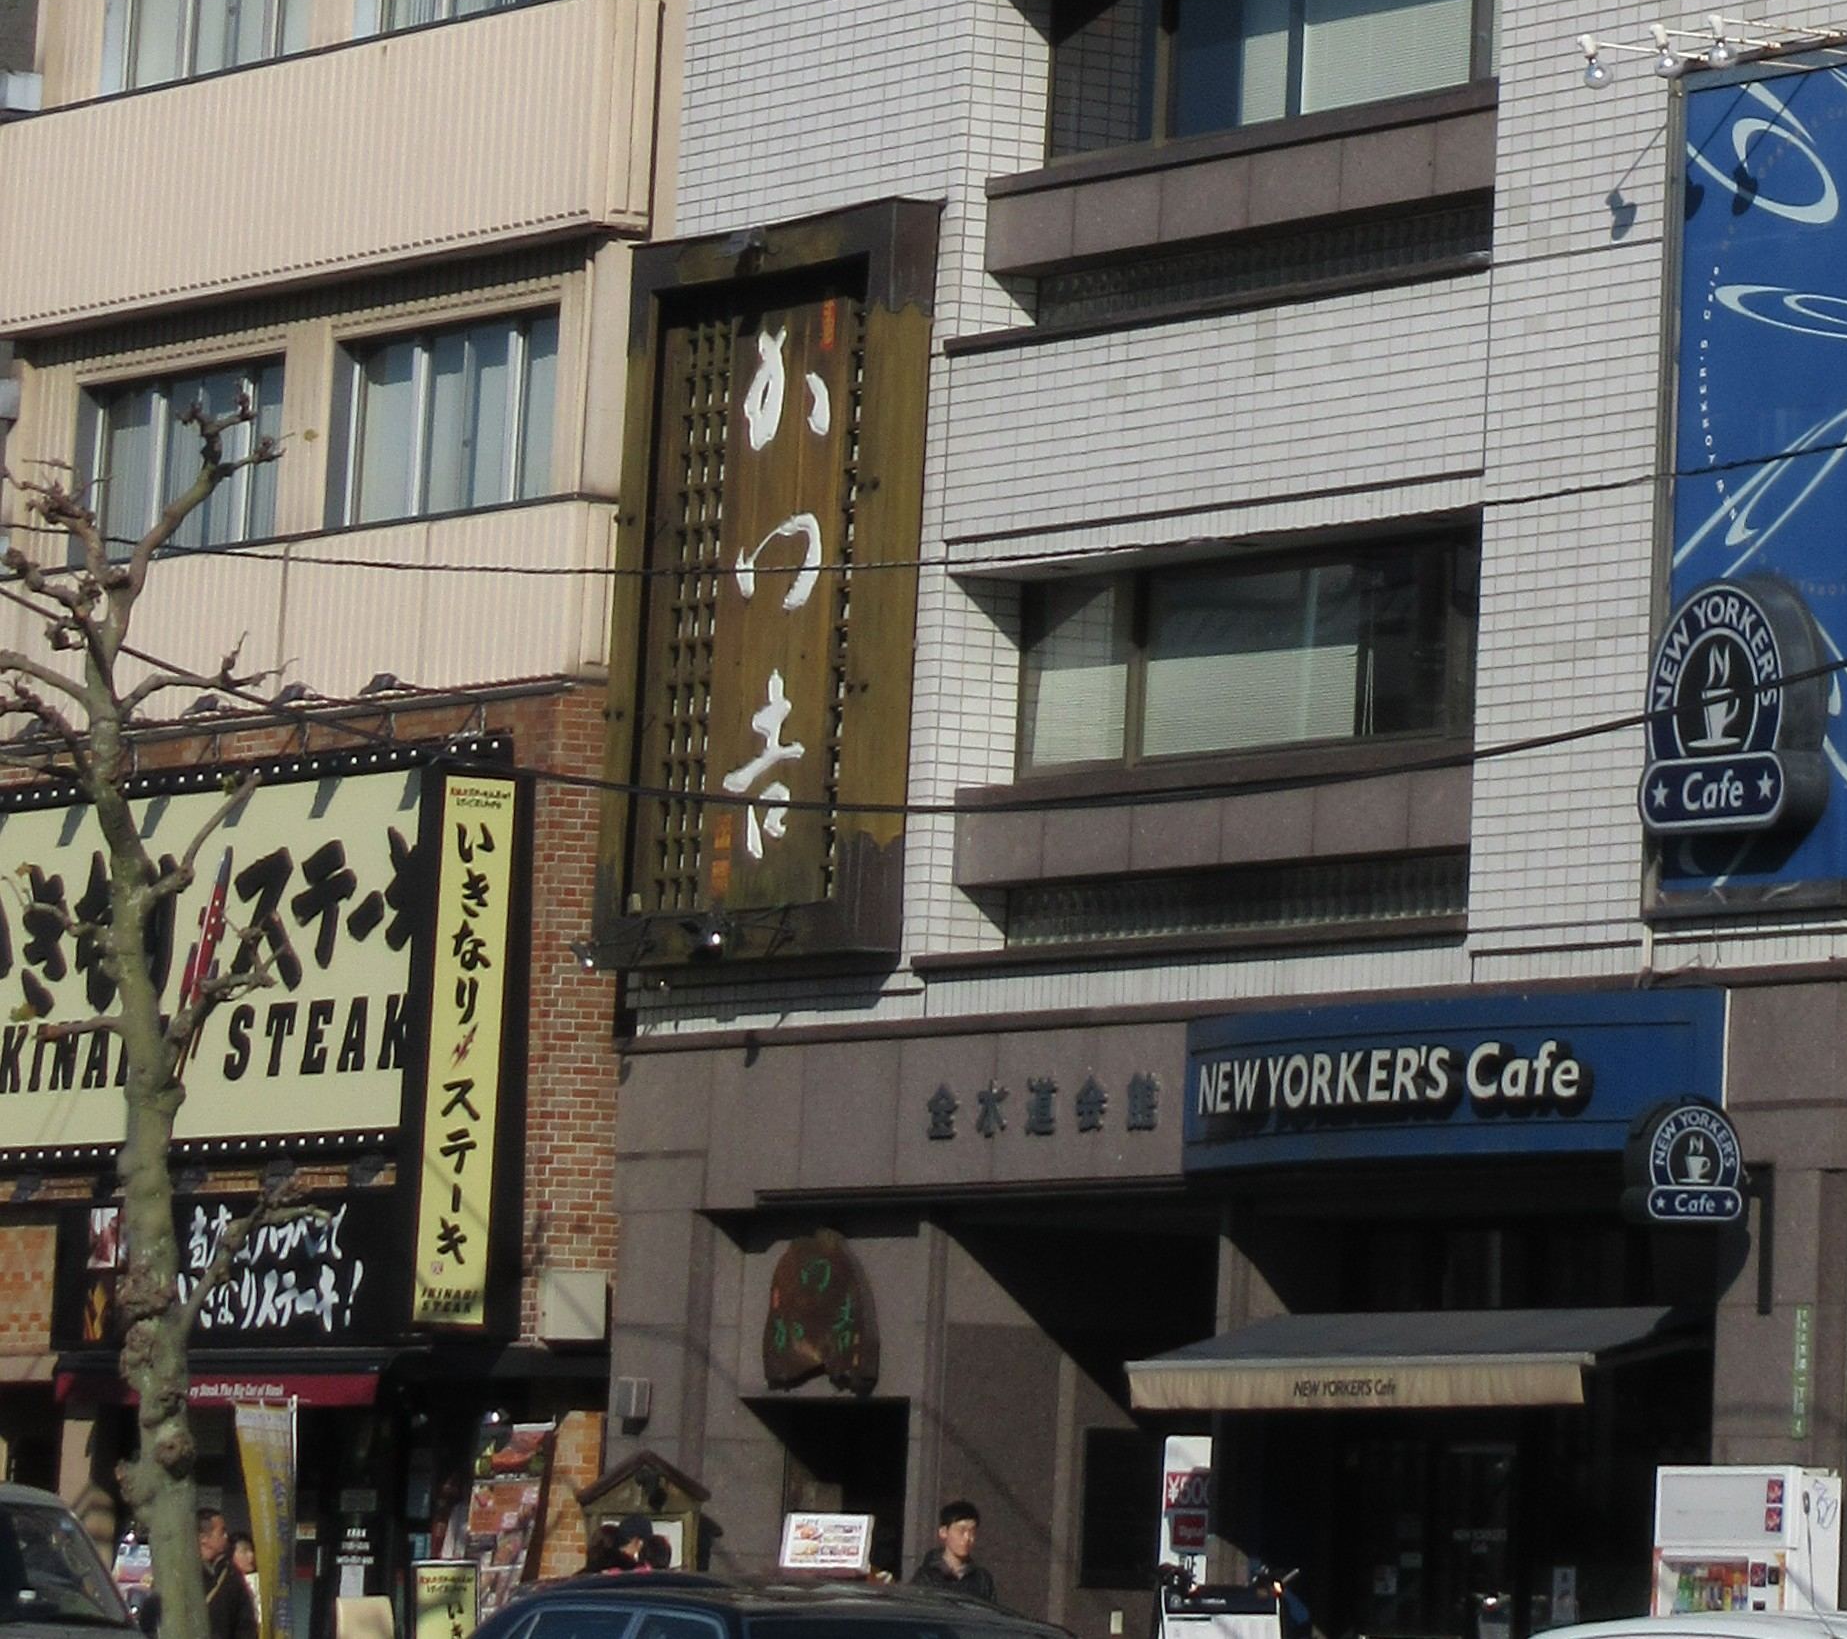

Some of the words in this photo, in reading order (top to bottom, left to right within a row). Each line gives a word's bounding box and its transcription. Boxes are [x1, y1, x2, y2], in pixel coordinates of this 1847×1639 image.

[1654, 618, 1691, 711] NEW
[1693, 595, 1780, 707] YORKER'S
[1682, 769, 1745, 812] Cafe
[1198, 1057, 1263, 1116] NEW
[1266, 1045, 1451, 1109] YORKER'S
[1466, 1040, 1583, 1099] Cafe
[1654, 1119, 1677, 1166] NEW
[1679, 1110, 1737, 1168] YORKER'S
[1675, 1193, 1717, 1214] Cafe
[1293, 1379, 1320, 1398] NEW
